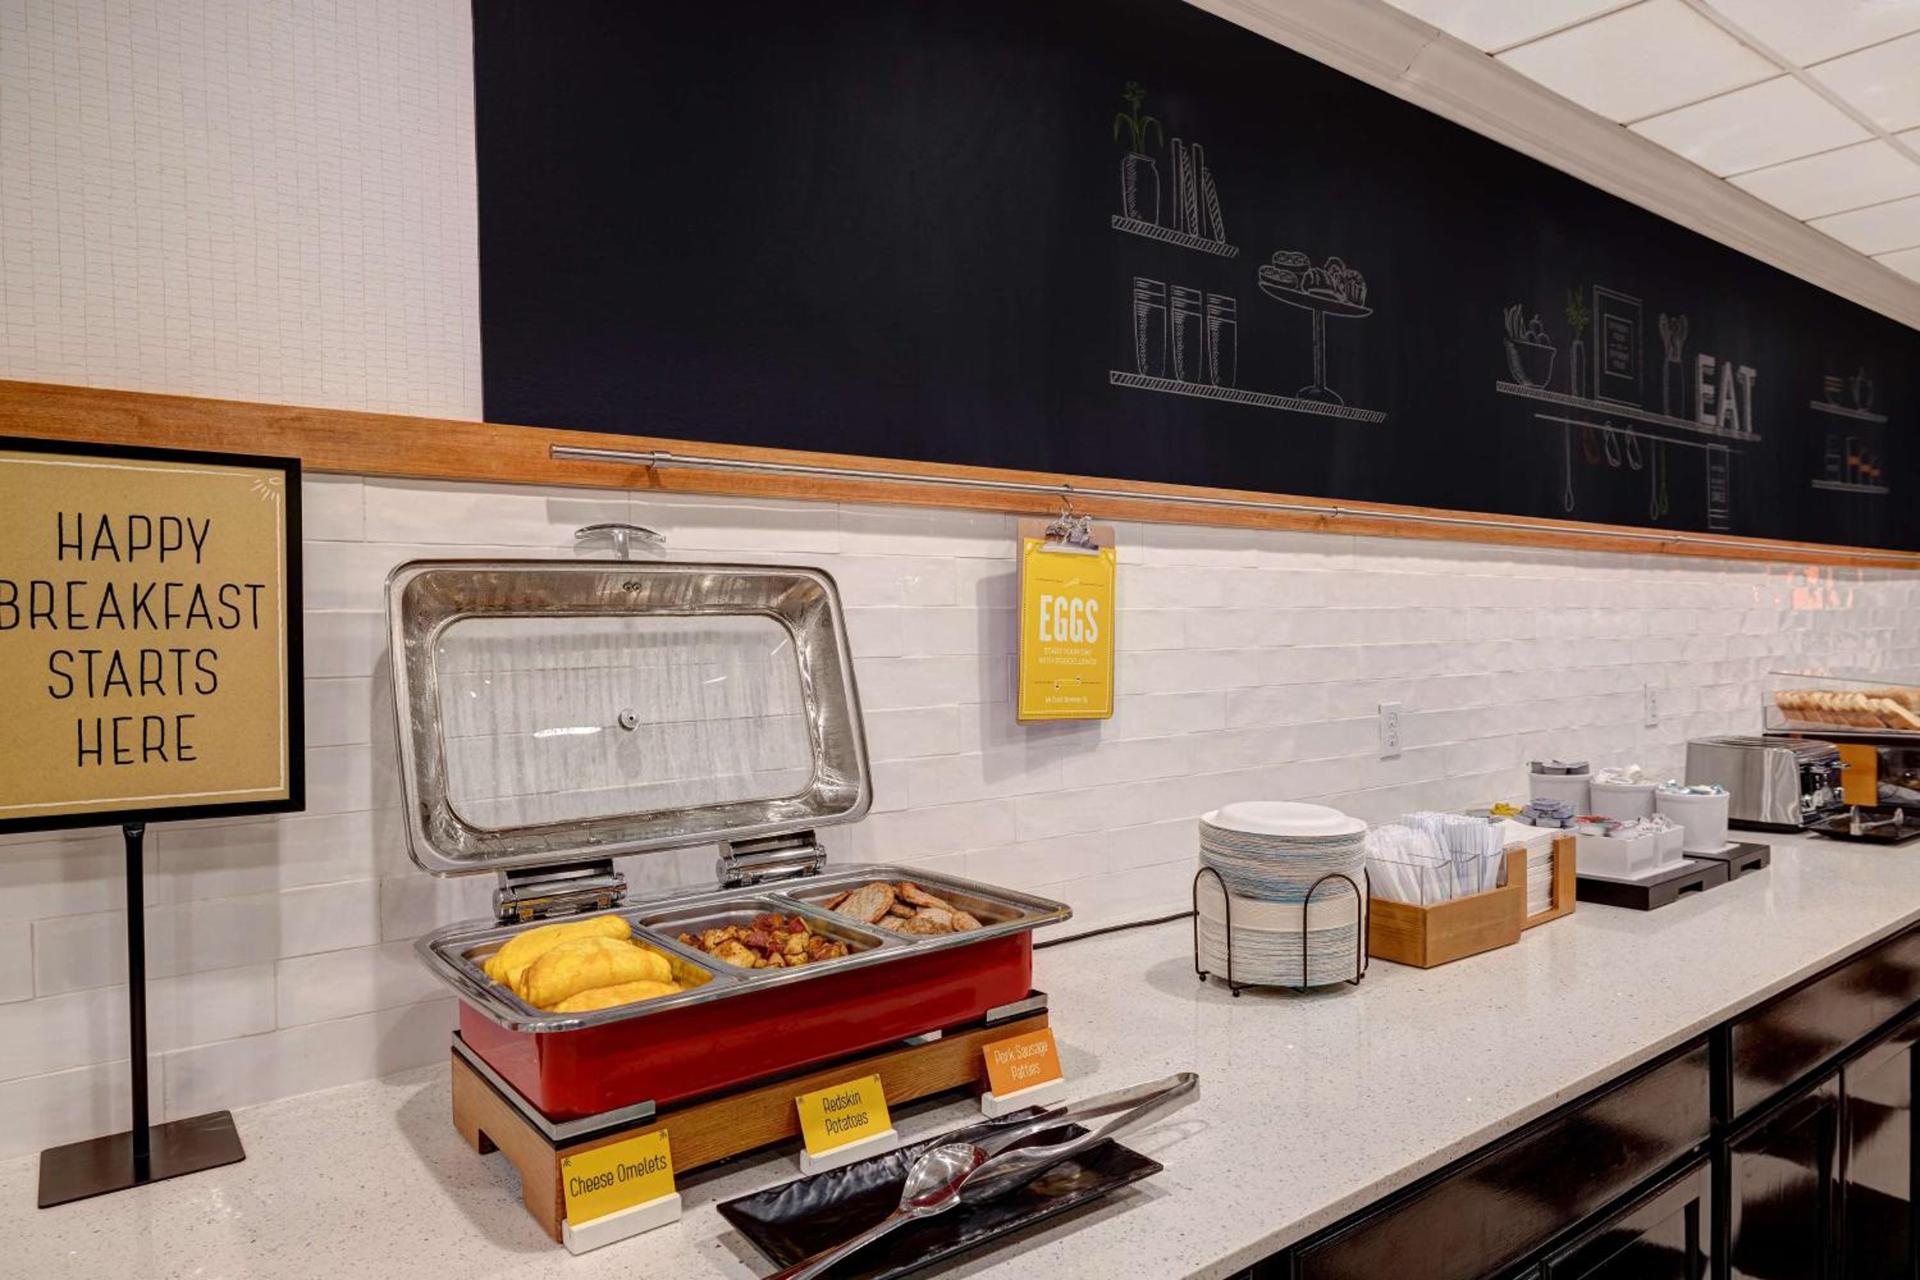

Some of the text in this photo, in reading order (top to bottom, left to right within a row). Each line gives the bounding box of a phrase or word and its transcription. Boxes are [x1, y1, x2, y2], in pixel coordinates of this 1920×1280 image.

[1696, 353, 1757, 432] EAT
[58, 511, 210, 564] HAPPY
[0, 580, 266, 630] BREAKFAST
[1039, 594, 1099, 643] EGGS
[48, 648, 218, 699] STARTS
[77, 715, 197, 767] HERE
[822, 1090, 862, 1114] Redskin
[825, 1111, 870, 1137] Potatoes
[569, 1154, 668, 1198] Cheese Omelets
